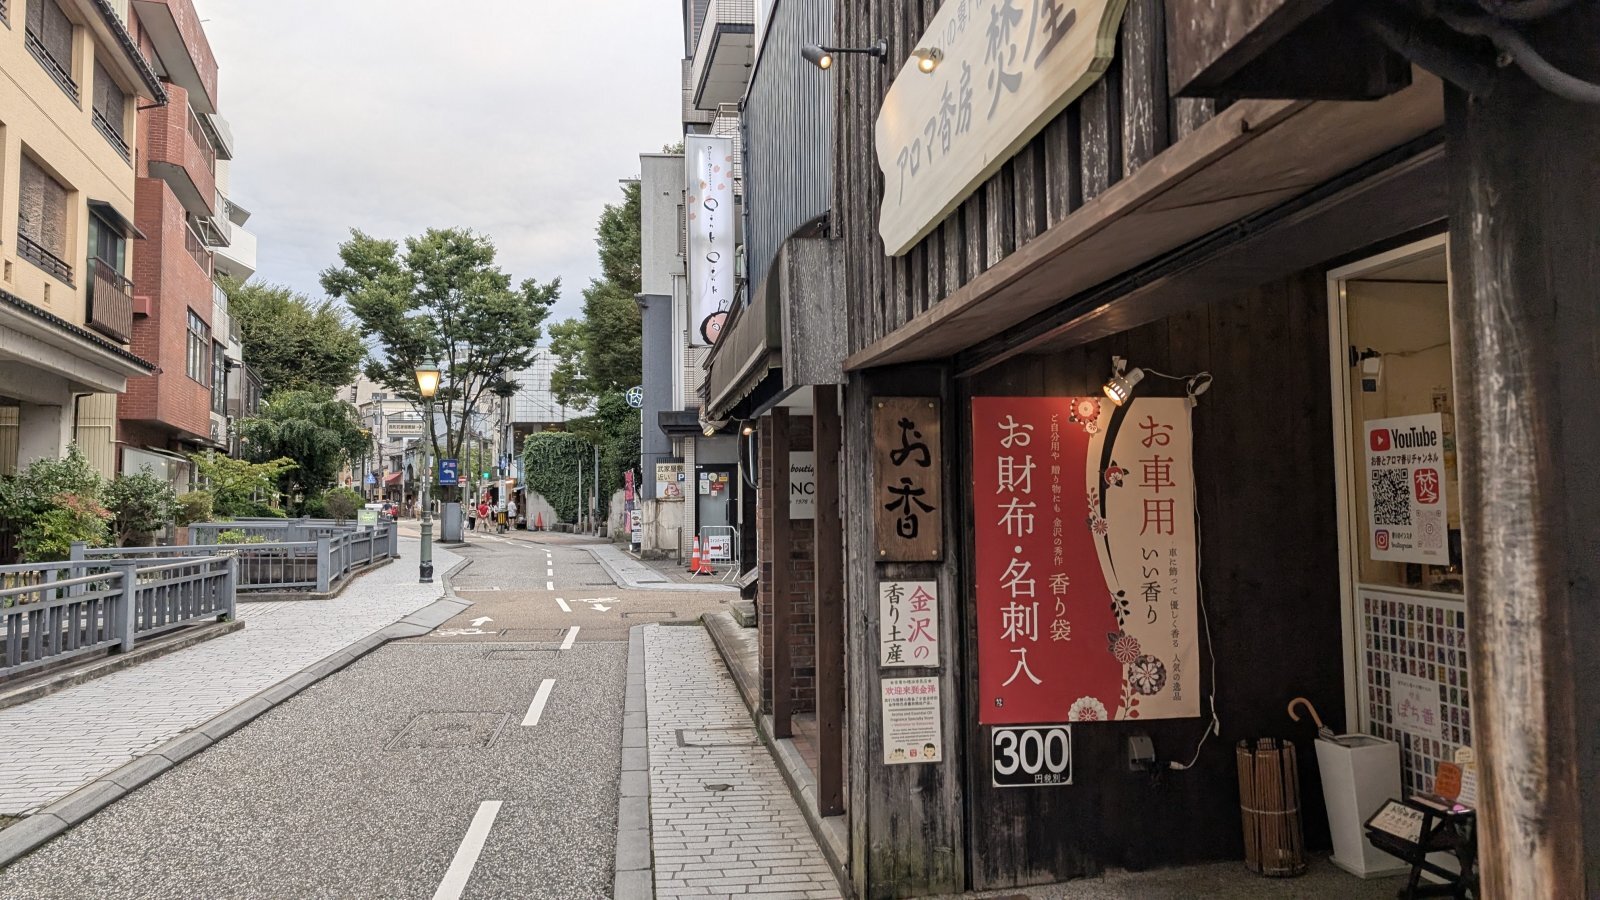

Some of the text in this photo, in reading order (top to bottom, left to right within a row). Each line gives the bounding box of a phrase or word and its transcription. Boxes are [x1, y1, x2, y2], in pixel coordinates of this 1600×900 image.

[896, 60, 973, 206] アロマ香房
[1139, 415, 1176, 536] お車用
[1391, 426, 1437, 449] YouTube
[678, 473, 685, 481] P
[884, 417, 936, 539] お香
[996, 414, 1042, 687] お財布・名刺入
[1141, 547, 1162, 625] いい香り
[883, 583, 906, 664] 香り土産
[908, 585, 937, 659] 金沢の
[1048, 573, 1072, 642] 香り袋
[995, 729, 1069, 775] 300
